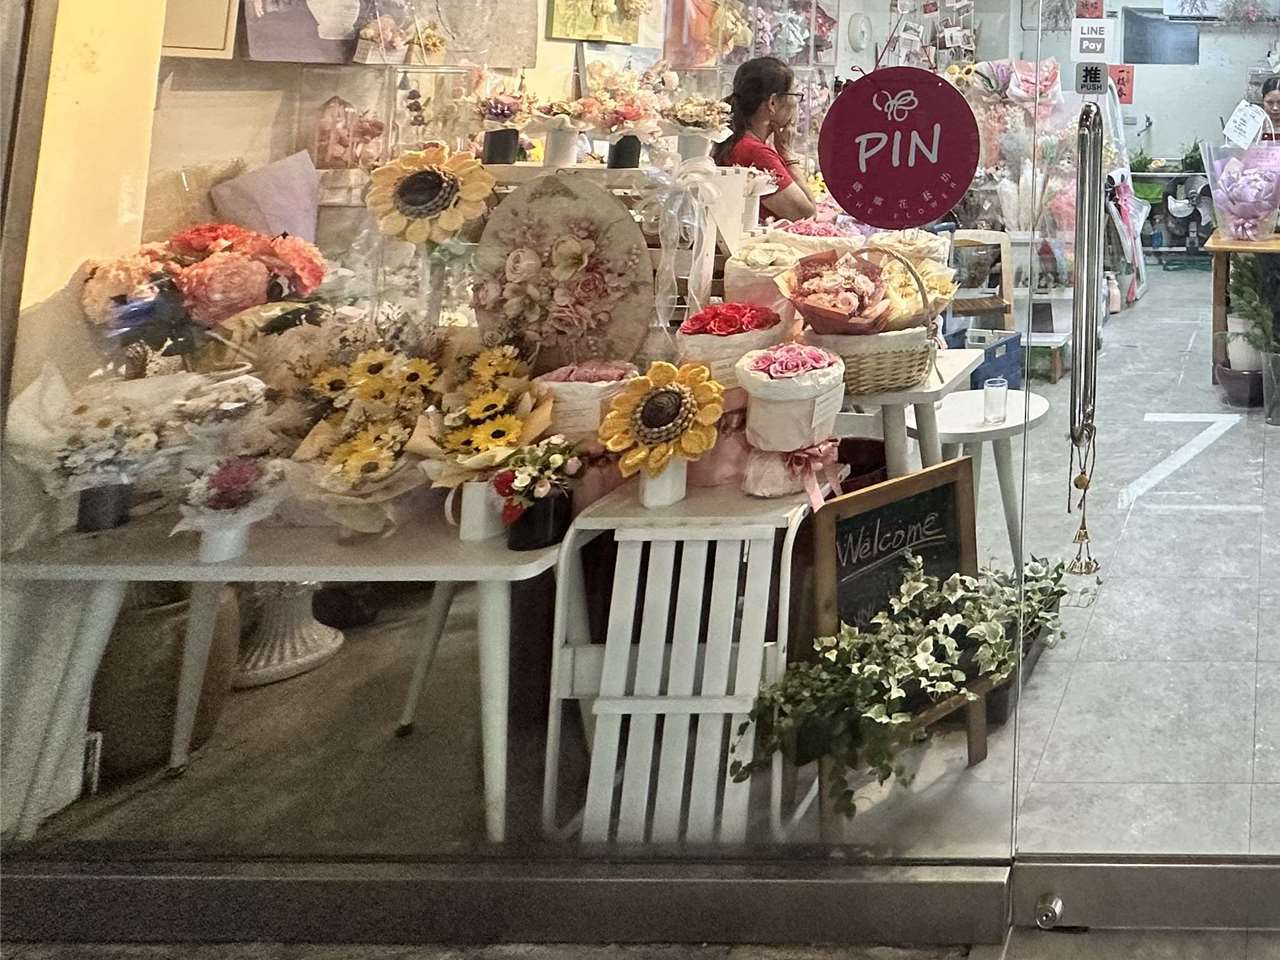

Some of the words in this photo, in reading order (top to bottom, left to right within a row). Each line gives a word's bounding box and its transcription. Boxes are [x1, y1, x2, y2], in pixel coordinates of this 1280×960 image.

[1080, 26, 1105, 35] LINE
[1082, 40, 1103, 50] Pay
[1082, 66, 1101, 83] 推
[1080, 83, 1102, 91] PUSH
[855, 123, 942, 173] PIN
[836, 512, 943, 567] Welcome
